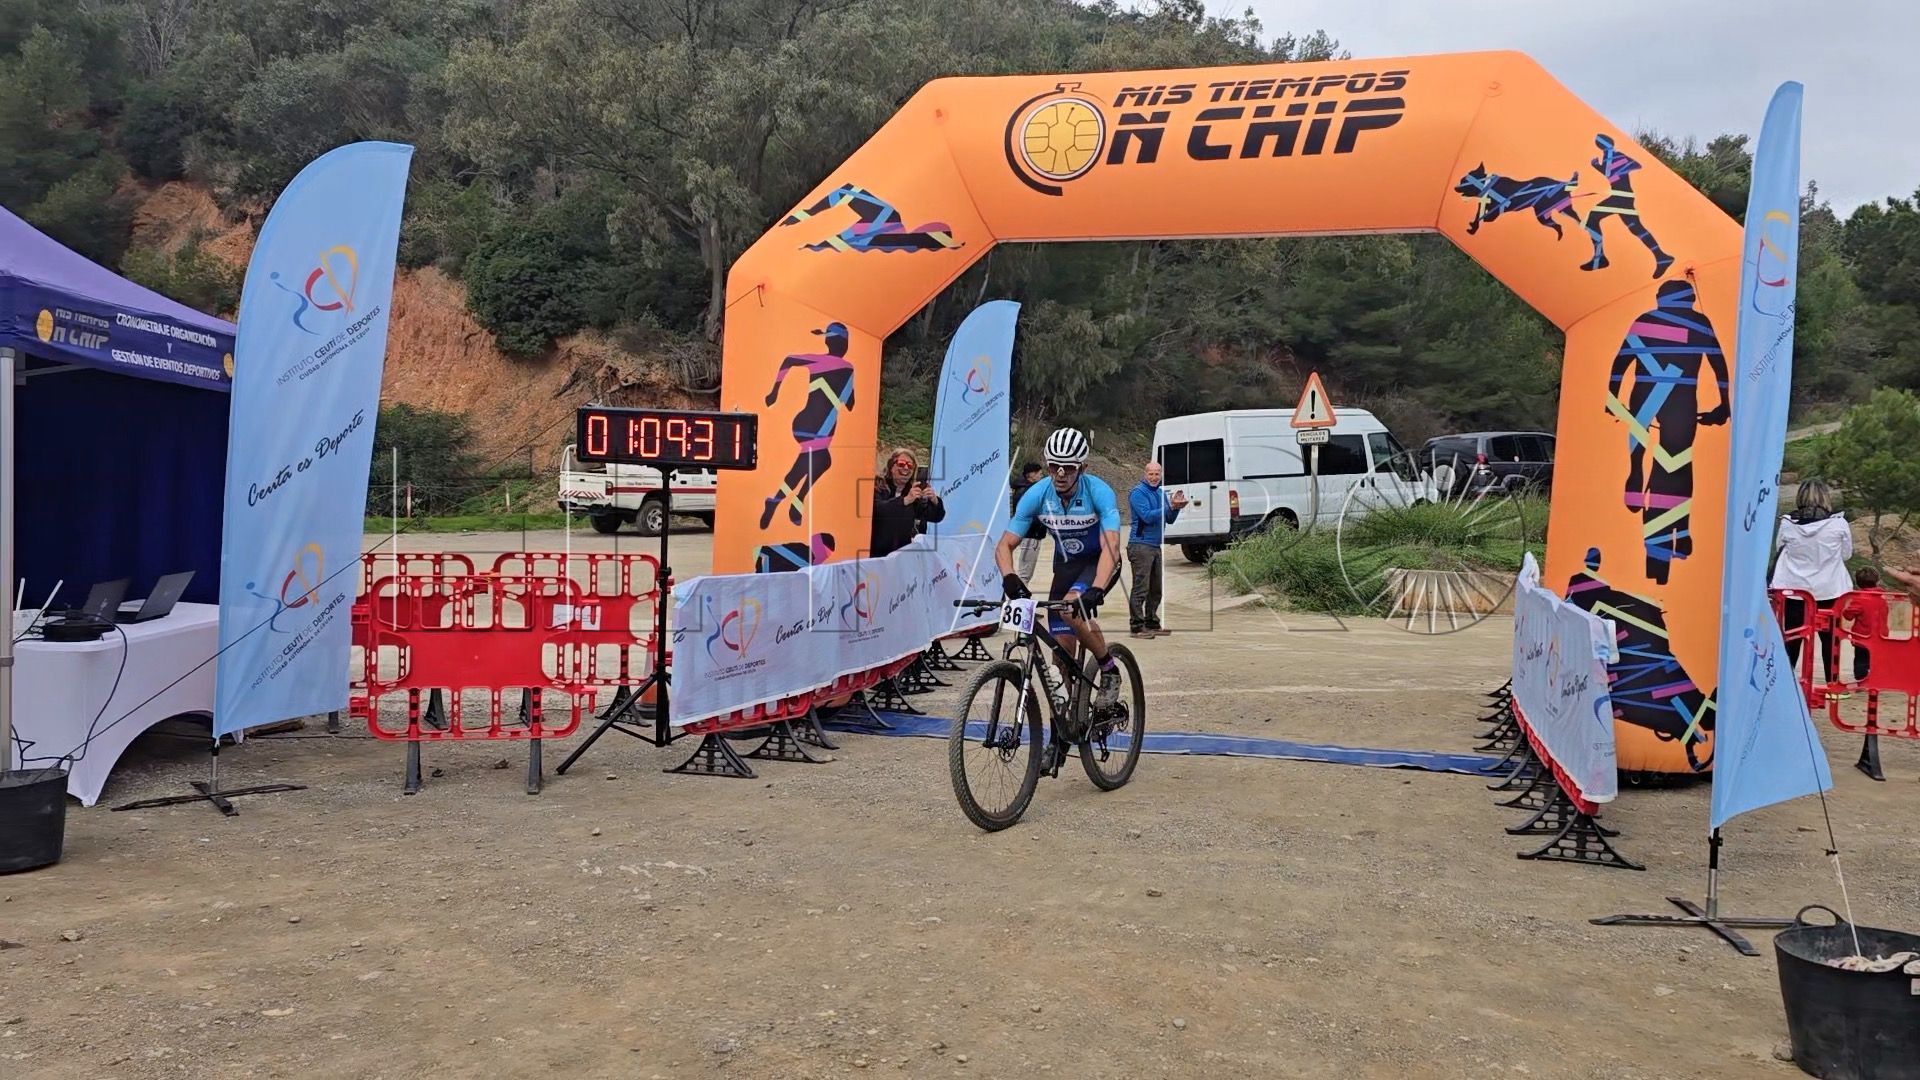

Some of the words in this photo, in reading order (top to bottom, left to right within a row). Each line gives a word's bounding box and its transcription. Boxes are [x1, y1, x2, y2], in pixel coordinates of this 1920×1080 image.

[1113, 83, 1197, 107] MIS
[1208, 70, 1410, 102] TIEMPOS
[1187, 97, 1406, 162] CHIP
[116, 312, 170, 337] CRONOMETRAJE
[170, 324, 217, 348] ORGANIZACIÓN
[276, 355, 314, 385] INSTITUTO
[336, 331, 346, 345] DE
[345, 305, 381, 336] DEPORTES
[112, 349, 144, 367] GESTIÓN
[143, 356, 154, 369] DE
[154, 357, 183, 374] EVENTOS
[183, 363, 220, 380] DEPORTIVOS
[167, 343, 173, 354] Y
[299, 363, 321, 380] CIUDAD
[248, 465, 292, 507] Ceuta
[298, 457, 313, 472] es
[315, 409, 364, 460] Deporte
[1061, 517, 1096, 526] URBANO
[1003, 605, 1023, 626] 36
[252, 653, 283, 690] INSTITUTO
[302, 624, 313, 638] DE
[312, 592, 346, 627] DEPORTES
